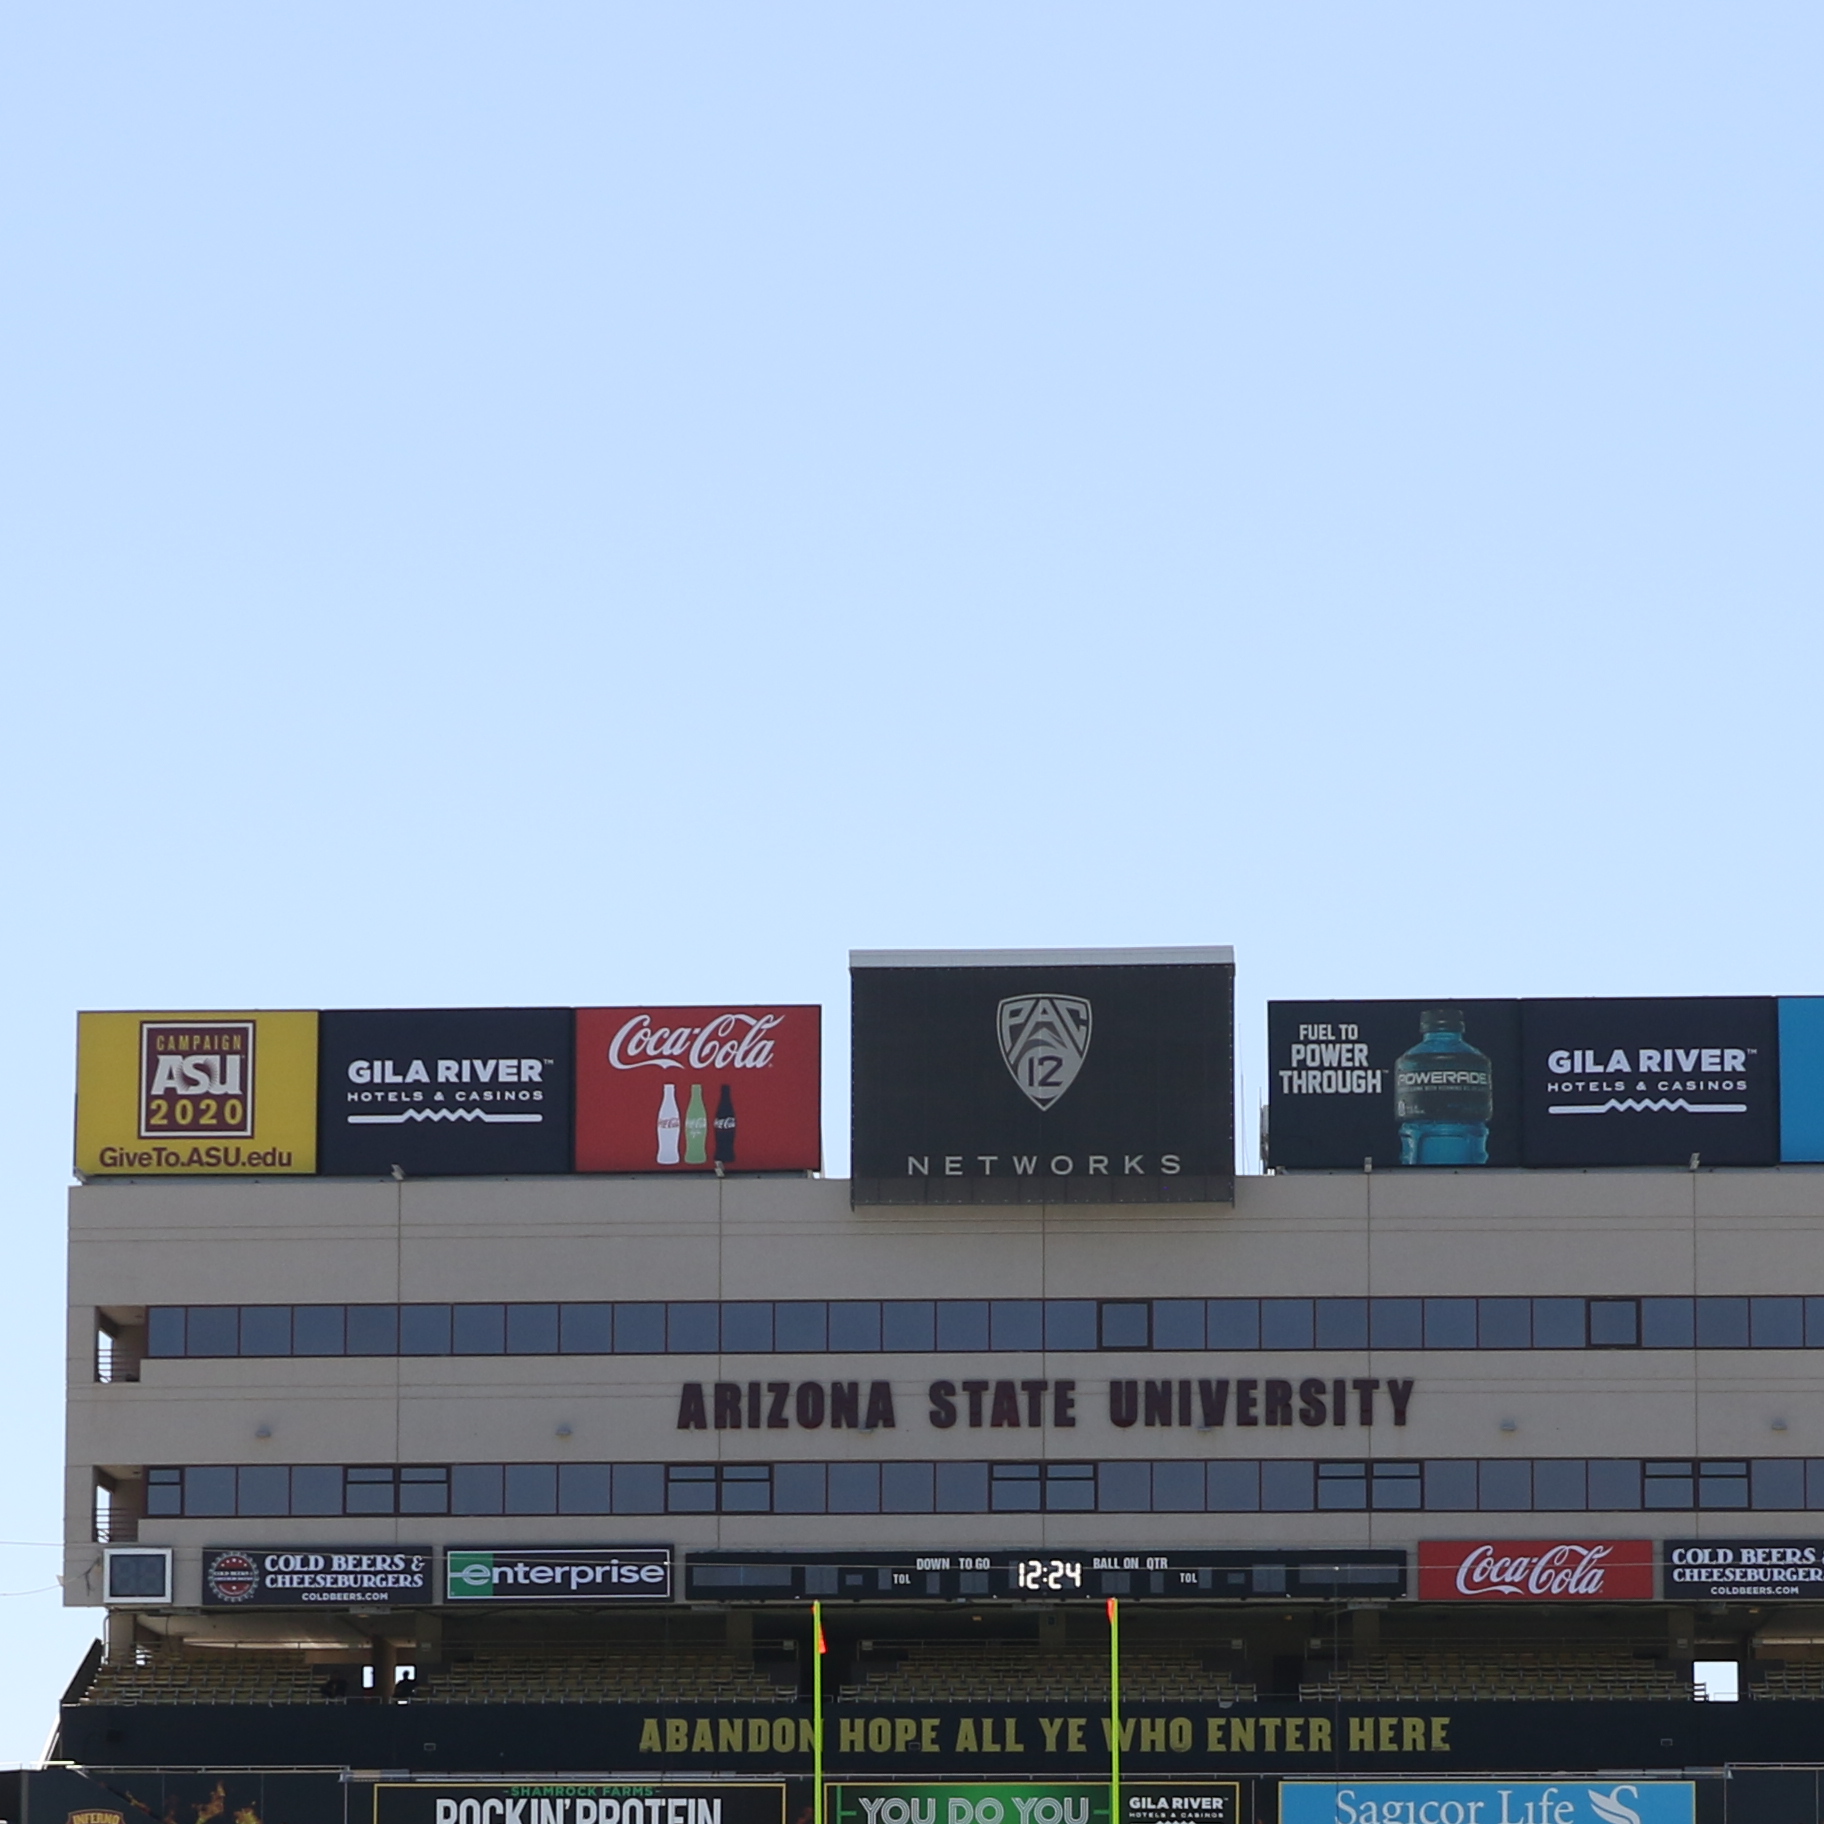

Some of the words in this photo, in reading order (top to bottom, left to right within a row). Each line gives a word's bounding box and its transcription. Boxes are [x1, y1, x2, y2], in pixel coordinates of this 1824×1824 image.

[1001, 999, 1089, 1063] PAC
[1299, 1024, 1335, 1040] FUEL
[1339, 1024, 1358, 1040] TO
[156, 1035, 241, 1050] CAMPAIGN
[608, 1014, 785, 1070] Coca-Cola
[1291, 1044, 1368, 1067] POWER
[1547, 1049, 1631, 1074] GILA
[1639, 1048, 1746, 1072] RIVER
[151, 1055, 242, 1095] ASU
[347, 1060, 430, 1084] GILA
[437, 1059, 543, 1082] RIVER
[1028, 1055, 1063, 1087] 12
[1397, 1071, 1487, 1086] POWERADE
[1279, 1070, 1382, 1094] THROUGH
[1548, 1081, 1626, 1092] HOTELS
[1636, 1081, 1647, 1091] &
[1657, 1080, 1747, 1091] CASINOS
[347, 1091, 423, 1101] HOTELS
[434, 1091, 445, 1101] &
[455, 1090, 543, 1101] CASINOS
[150, 1099, 242, 1125] 2020
[99, 1147, 292, 1168] GiveTo.ASU.edu
[907, 1155, 1181, 1175] NETWORKS
[677, 1380, 896, 1430] ARIZONA
[928, 1380, 1076, 1429] STATE
[1109, 1378, 1416, 1429] UNIVERSITY
[264, 1554, 325, 1573] COLD
[331, 1554, 406, 1571] BEERS
[411, 1555, 425, 1570] &
[916, 1558, 950, 1571] DOWN
[958, 1558, 974, 1570] TO
[975, 1557, 990, 1570] GO
[1093, 1557, 1121, 1570] BALL
[1123, 1557, 1139, 1570] ON
[1146, 1557, 1168, 1571] QTR
[1671, 1548, 1733, 1565] COLD
[1740, 1547, 1816, 1564] BEERS
[462, 1558, 664, 1590] enterprise
[1018, 1560, 1081, 1591] 12:24
[1456, 1545, 1614, 1595] Coca-Cola
[265, 1574, 424, 1589] CHEESEBURGERS
[1711, 1586, 1799, 1595] COLDBEERS.COM
[301, 1592, 388, 1601] COLDBEERS.COM
[639, 1718, 824, 1753] ABANDON
[839, 1718, 941, 1753] HOPE
[956, 1718, 1024, 1753] ALL
[1038, 1718, 1087, 1753] YE
[1101, 1718, 1193, 1752] WHO
[1207, 1717, 1332, 1752] ENTER
[1348, 1717, 1451, 1752] HERE
[510, 1785, 597, 1797] SHAMROCK
[602, 1785, 653, 1797] FARMS
[1129, 1796, 1169, 1810] GILA
[1172, 1796, 1224, 1810] RIVER
[1180, 1811, 1224, 1819] CASINOS
